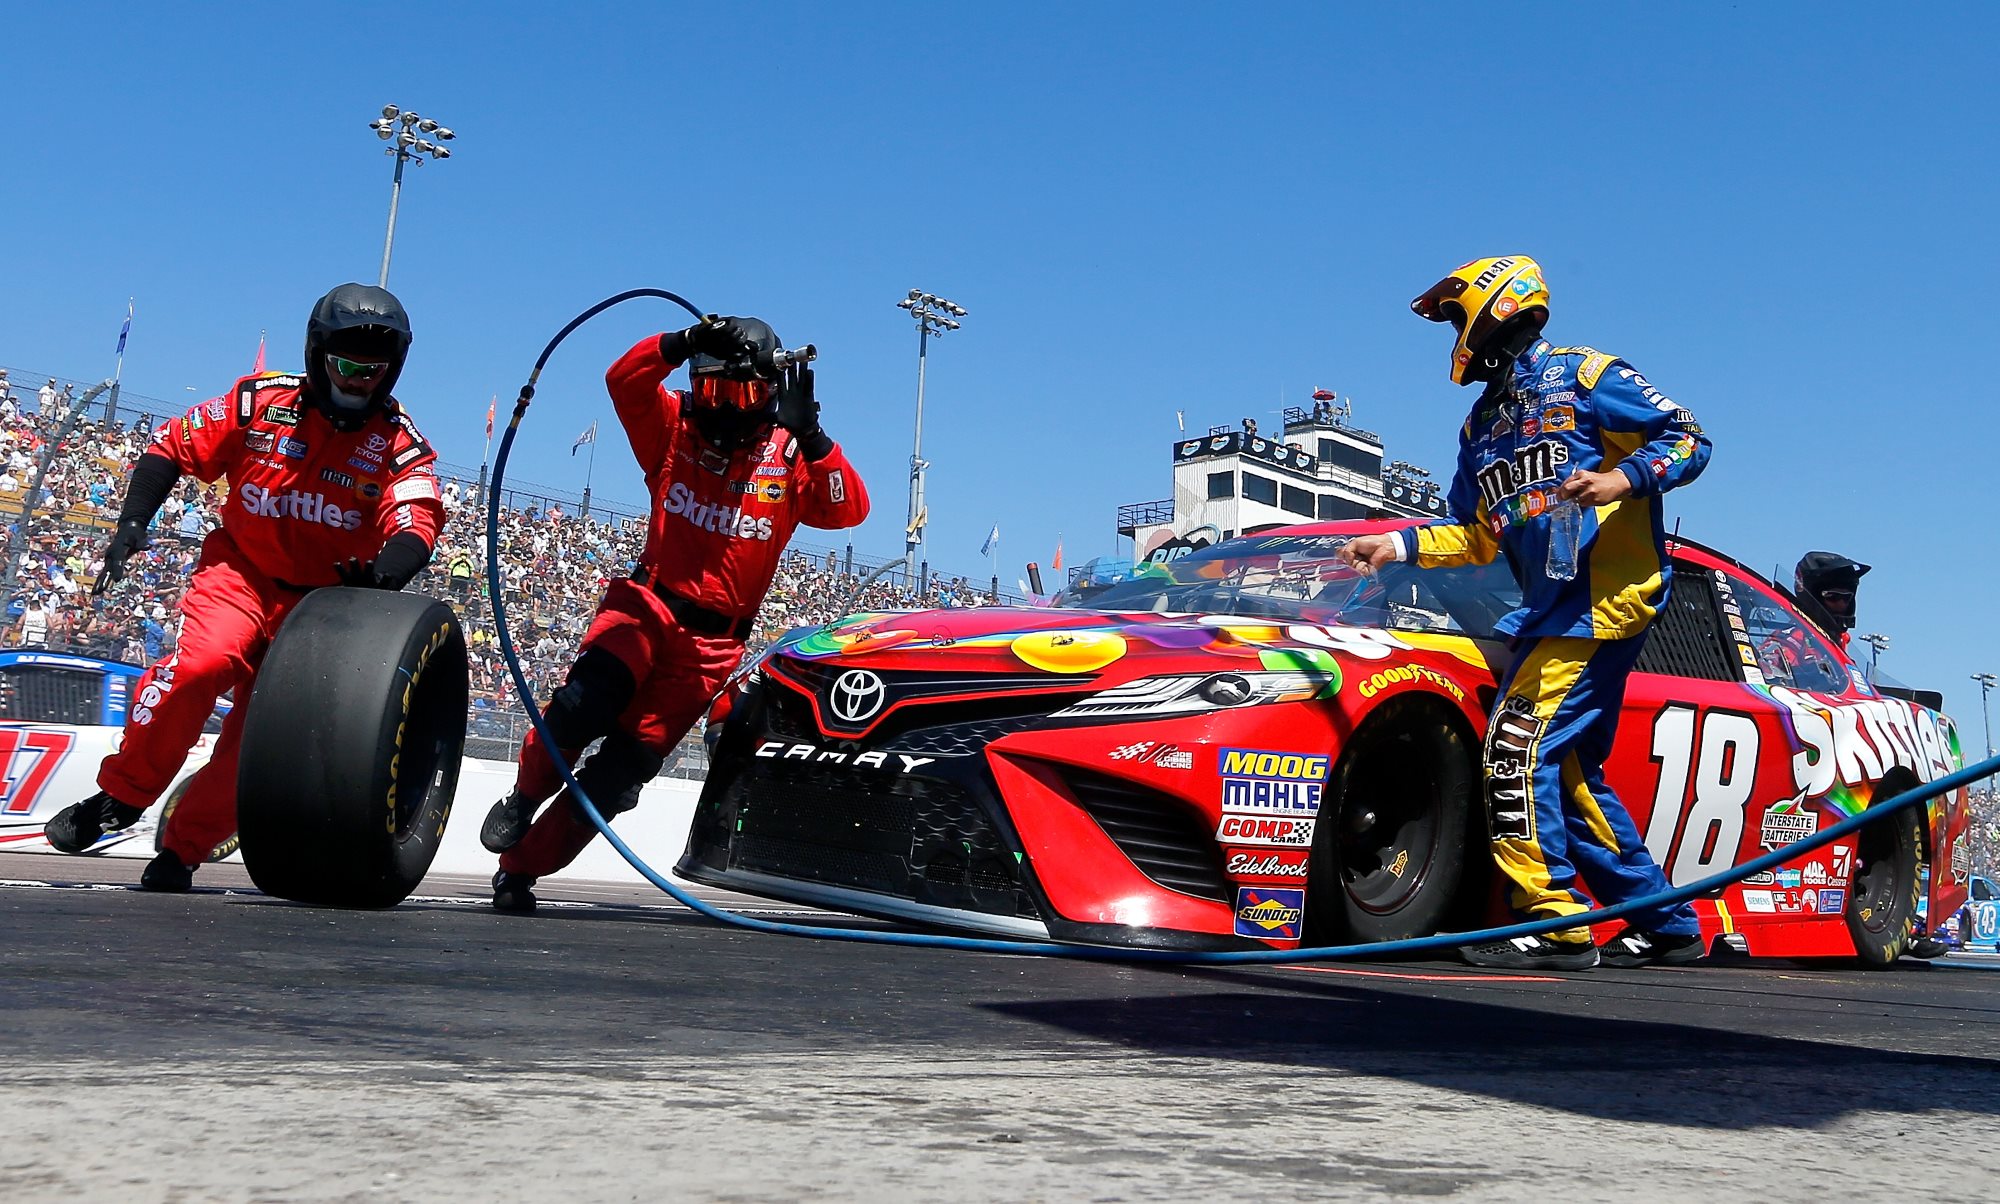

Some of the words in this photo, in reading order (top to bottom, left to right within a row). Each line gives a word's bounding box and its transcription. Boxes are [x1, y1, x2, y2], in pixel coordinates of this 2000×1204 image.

[255, 376, 300, 390] Skittles
[1537, 380, 1564, 392] TOYOTA
[354, 446, 383, 463] TOYOTA
[240, 482, 362, 531] Skittles
[664, 482, 773, 541] Skittles
[1358, 664, 1465, 702] GOODYEAR
[1156, 761, 1192, 769] RACING
[1222, 751, 1328, 779] MOOG
[1223, 780, 1320, 810] MAHLE
[1646, 700, 1760, 897] 18
[1222, 818, 1294, 838] COMP
[1764, 814, 1813, 828] INTERSTATE
[1270, 836, 1306, 844] CAMS
[1764, 829, 1810, 842] BATTERIES
[1226, 853, 1308, 878] Edelbrock
[1803, 861, 1827, 878] MAC
[1775, 873, 1801, 881] DOOSAN
[1827, 876, 1847, 887] Cessna
[1747, 896, 1771, 906] SIEMENS
[1242, 906, 1300, 923] SUNOCO
[1981, 904, 1997, 934] 43
